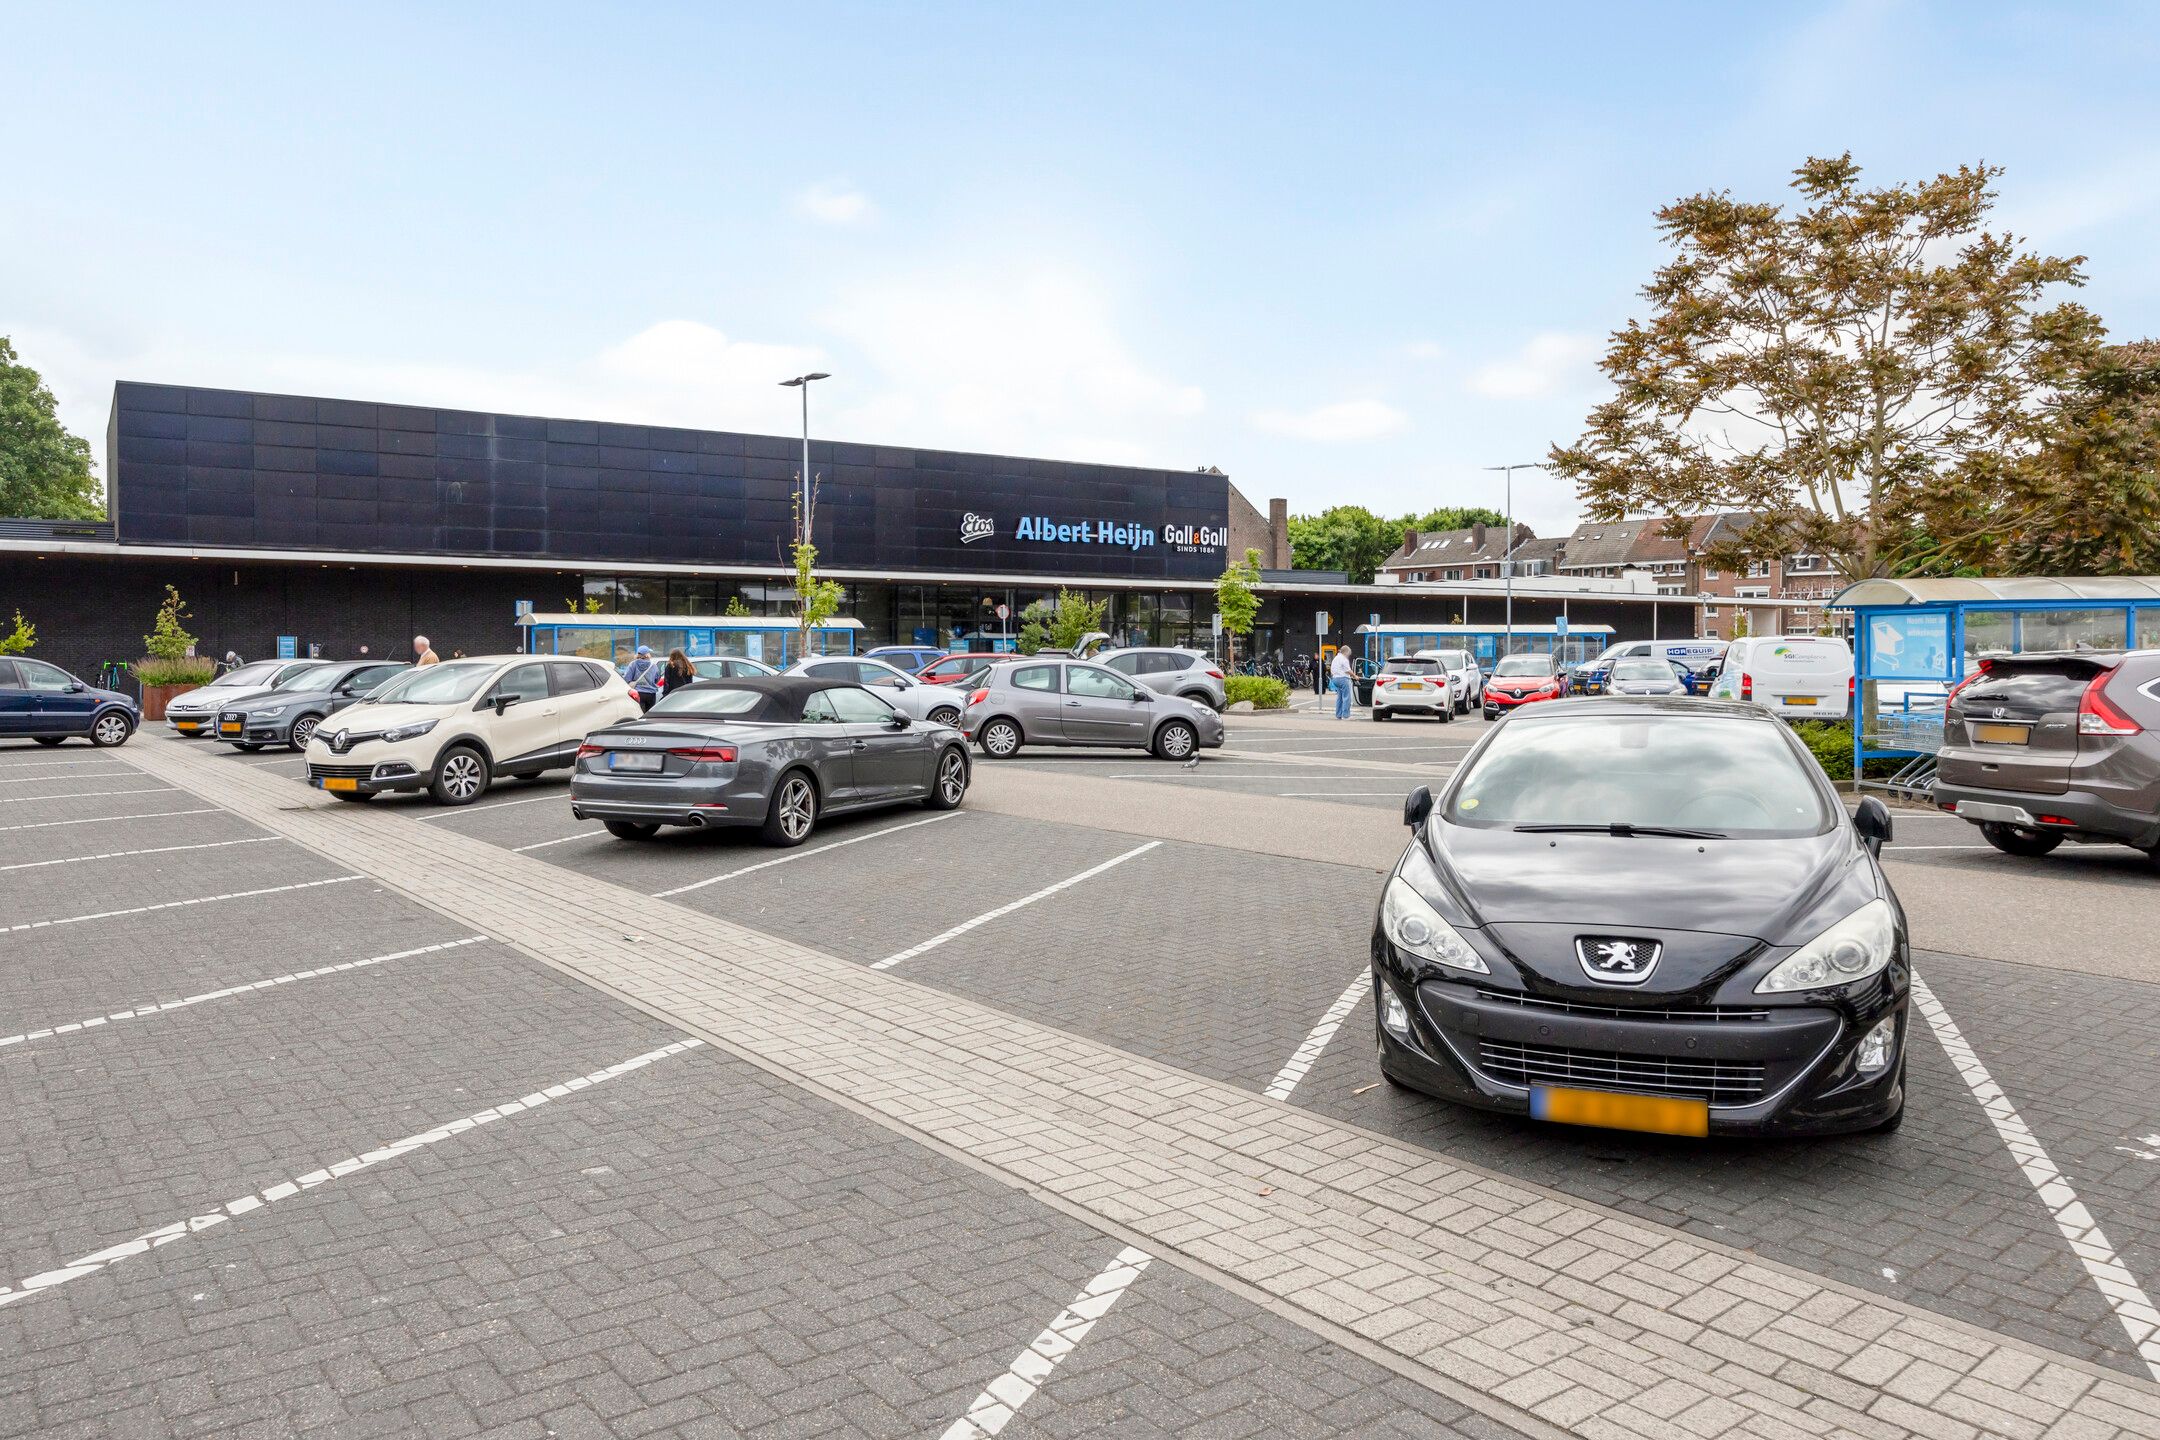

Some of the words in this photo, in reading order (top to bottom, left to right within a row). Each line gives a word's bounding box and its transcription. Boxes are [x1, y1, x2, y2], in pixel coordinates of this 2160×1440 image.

[961, 513, 994, 536] Etos
[1016, 517, 1090, 543] Albert
[1098, 521, 1154, 550] Heijn
